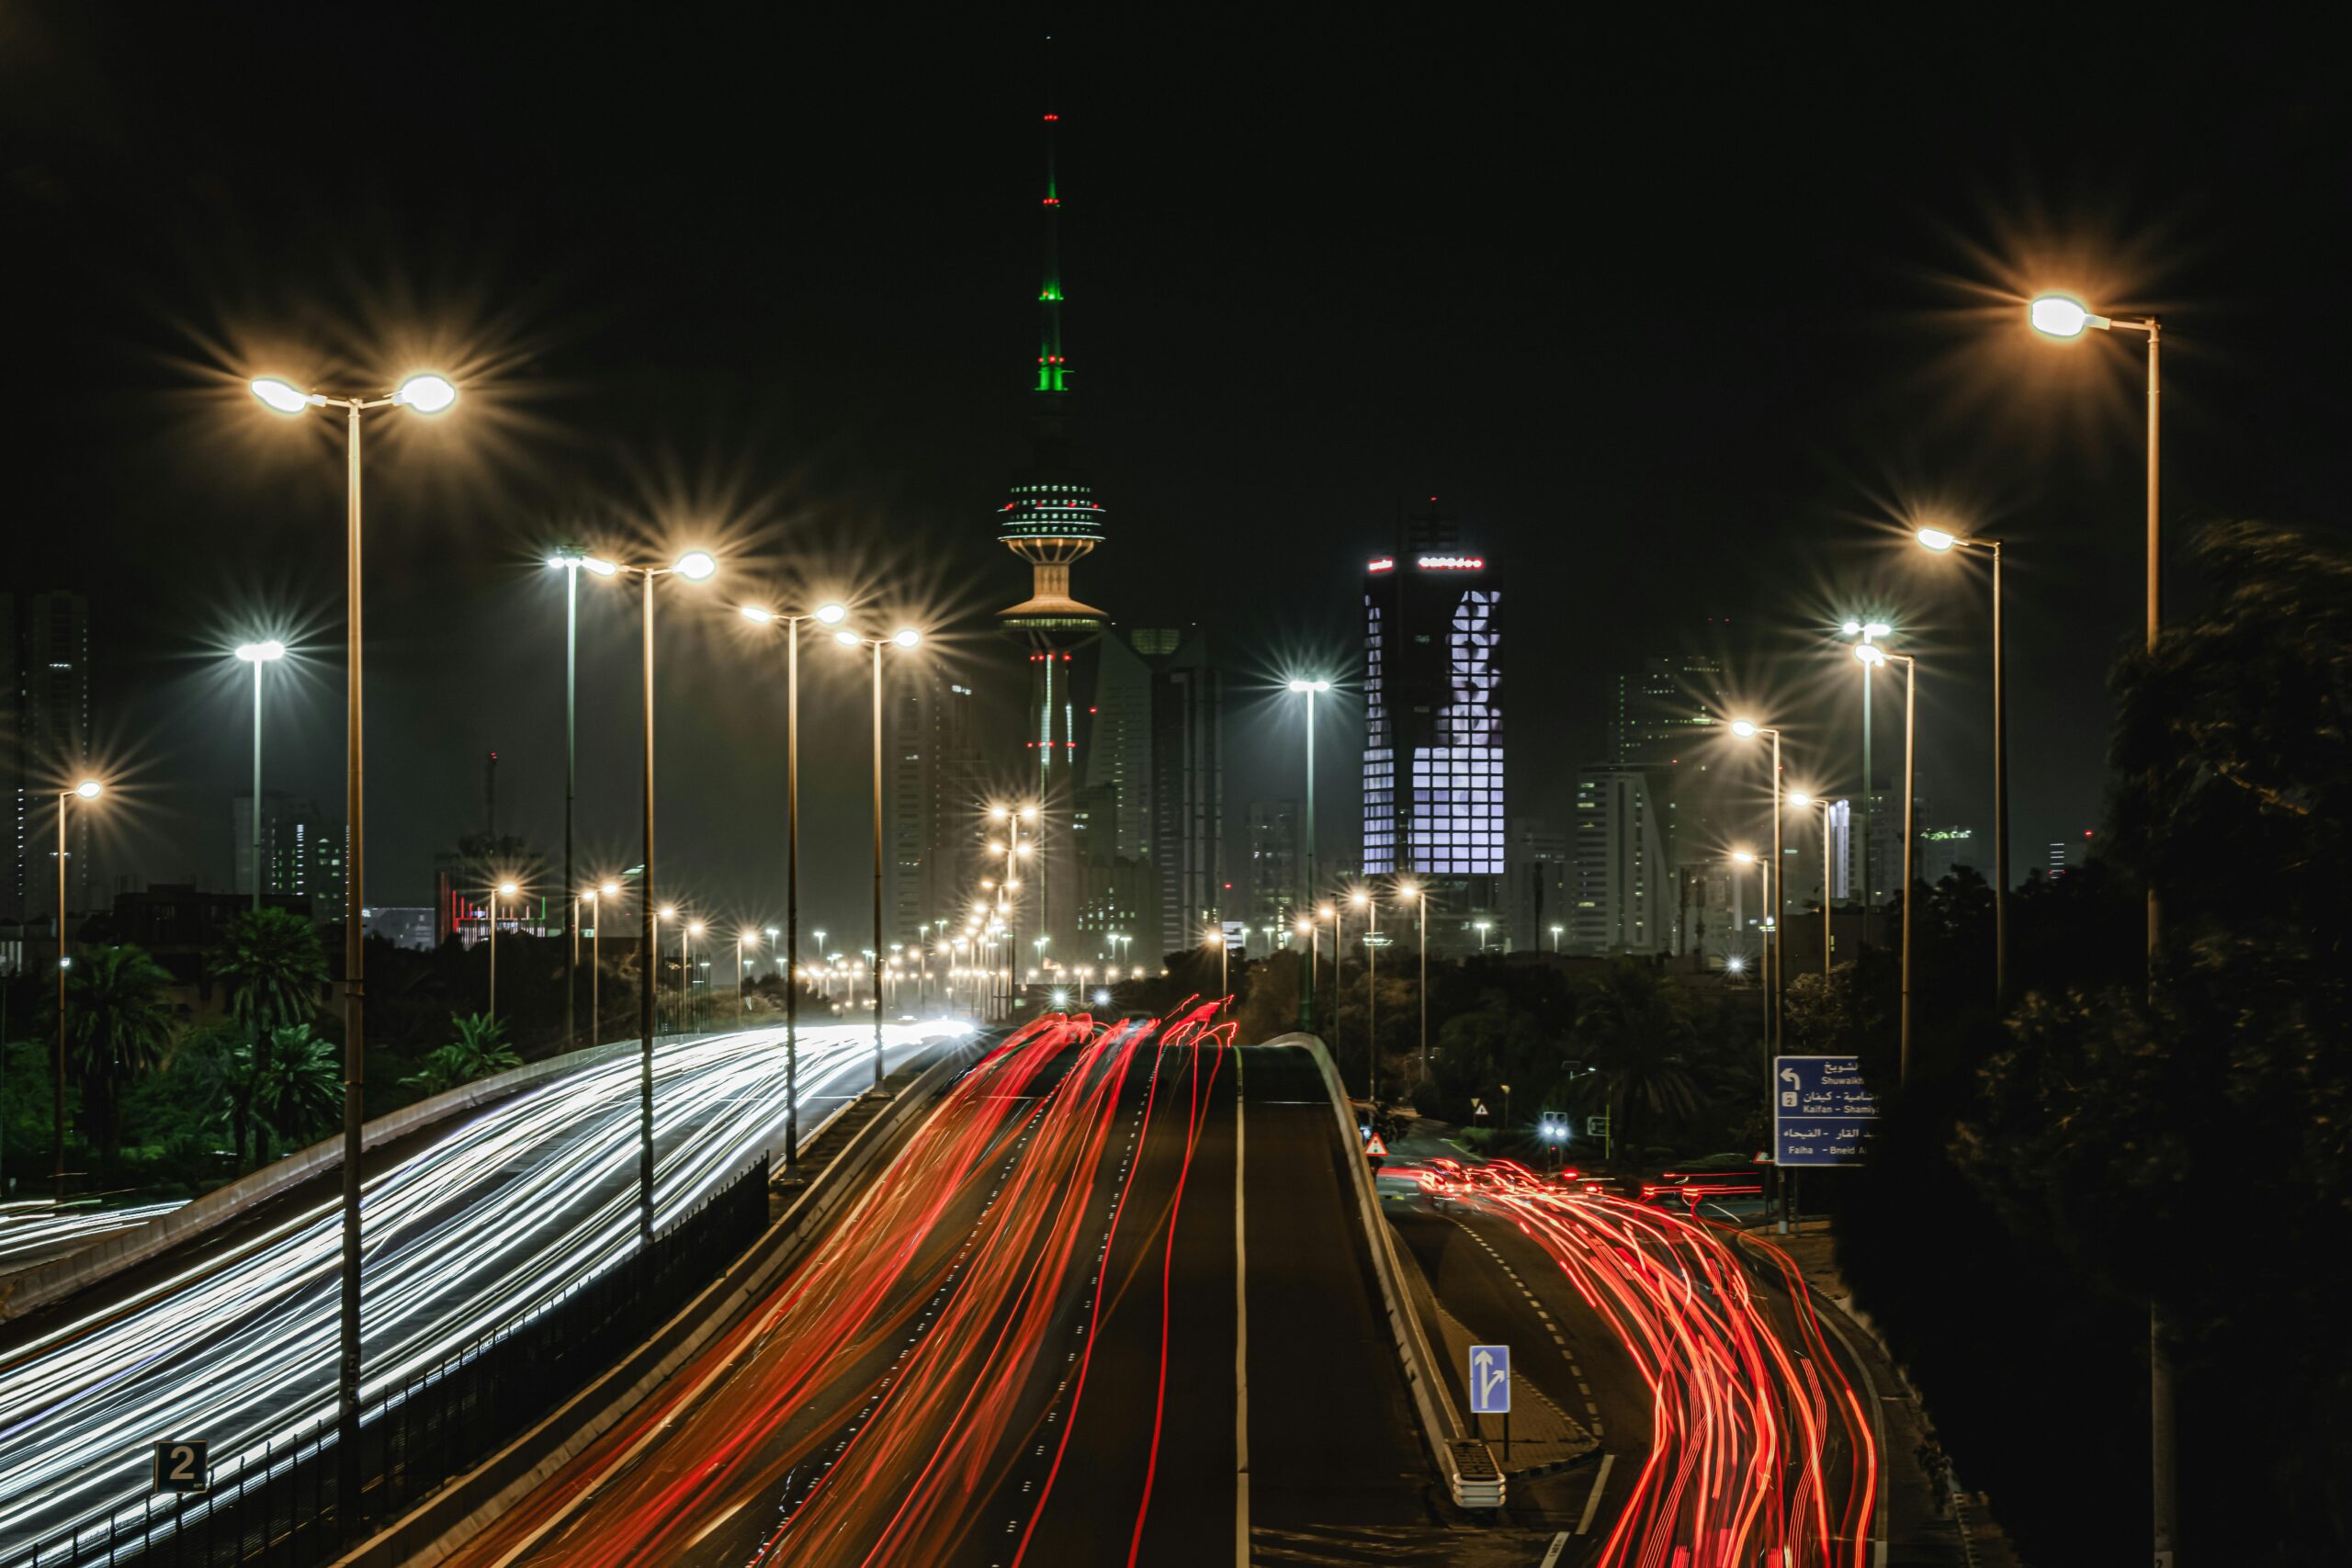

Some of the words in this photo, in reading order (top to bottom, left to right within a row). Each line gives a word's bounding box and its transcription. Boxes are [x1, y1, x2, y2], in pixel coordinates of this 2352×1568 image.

[1824, 1061, 1860, 1075] لشويخ
[1803, 1105, 1833, 1113] Kaifan
[1788, 1145, 1814, 1155] Faiha
[1829, 1145, 1856, 1155] Bneid
[169, 1445, 195, 1480] 2
